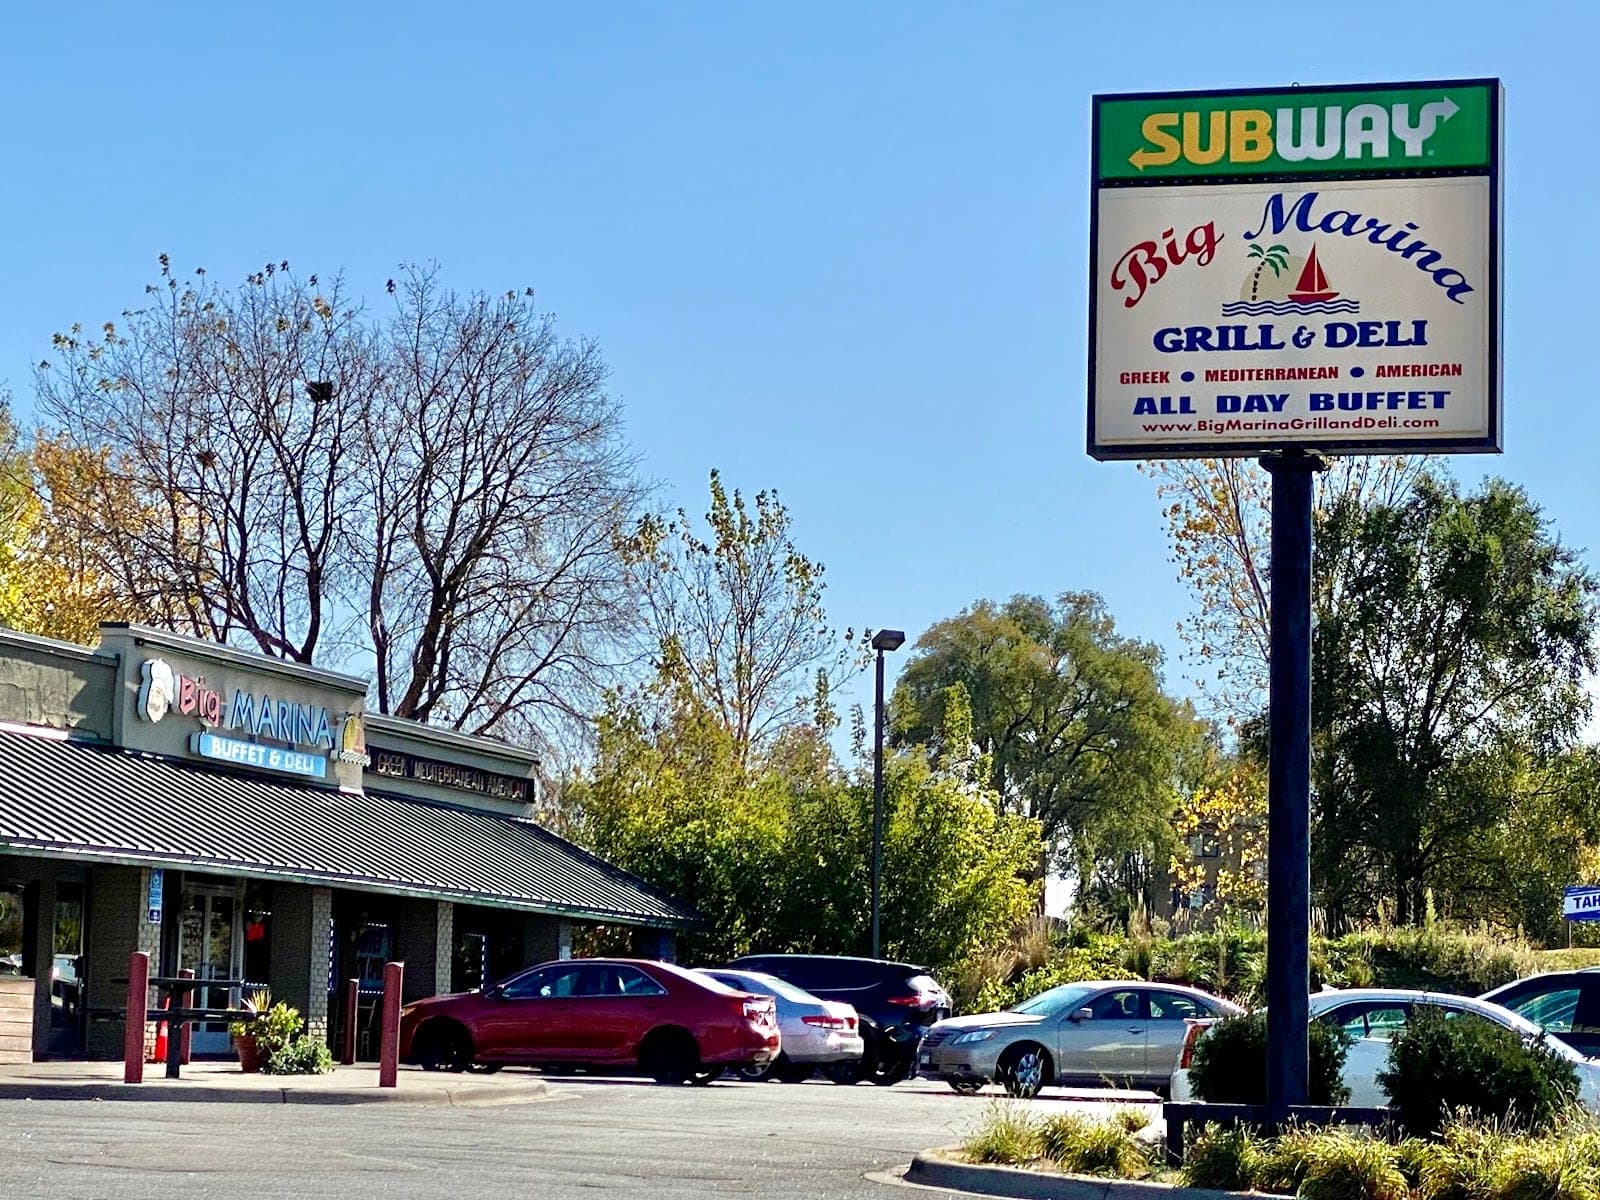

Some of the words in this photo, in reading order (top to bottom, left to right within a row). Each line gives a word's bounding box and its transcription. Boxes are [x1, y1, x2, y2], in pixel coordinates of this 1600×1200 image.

[1128, 97, 1459, 170] SUBWAY
[1111, 221, 1224, 308] Big
[1243, 192, 1474, 304] Marina
[1153, 324, 1285, 353] GRILL
[1292, 326, 1316, 348] &
[1324, 320, 1428, 348] DELI
[1119, 371, 1170, 385] GREEK
[1205, 366, 1338, 383] MEDITERRANEAN
[1375, 363, 1463, 378] AMERICAN
[1132, 395, 1197, 415] ALL
[1216, 394, 1290, 413] DAY
[1309, 391, 1451, 411] BUFFET
[1142, 416, 1440, 434] www.BigMarinaGrillandDeli.com
[179, 674, 221, 727] Big
[231, 689, 333, 749] MARINA
[211, 738, 266, 760] BUFFET
[269, 753, 281, 766] &
[286, 756, 314, 772] DELI
